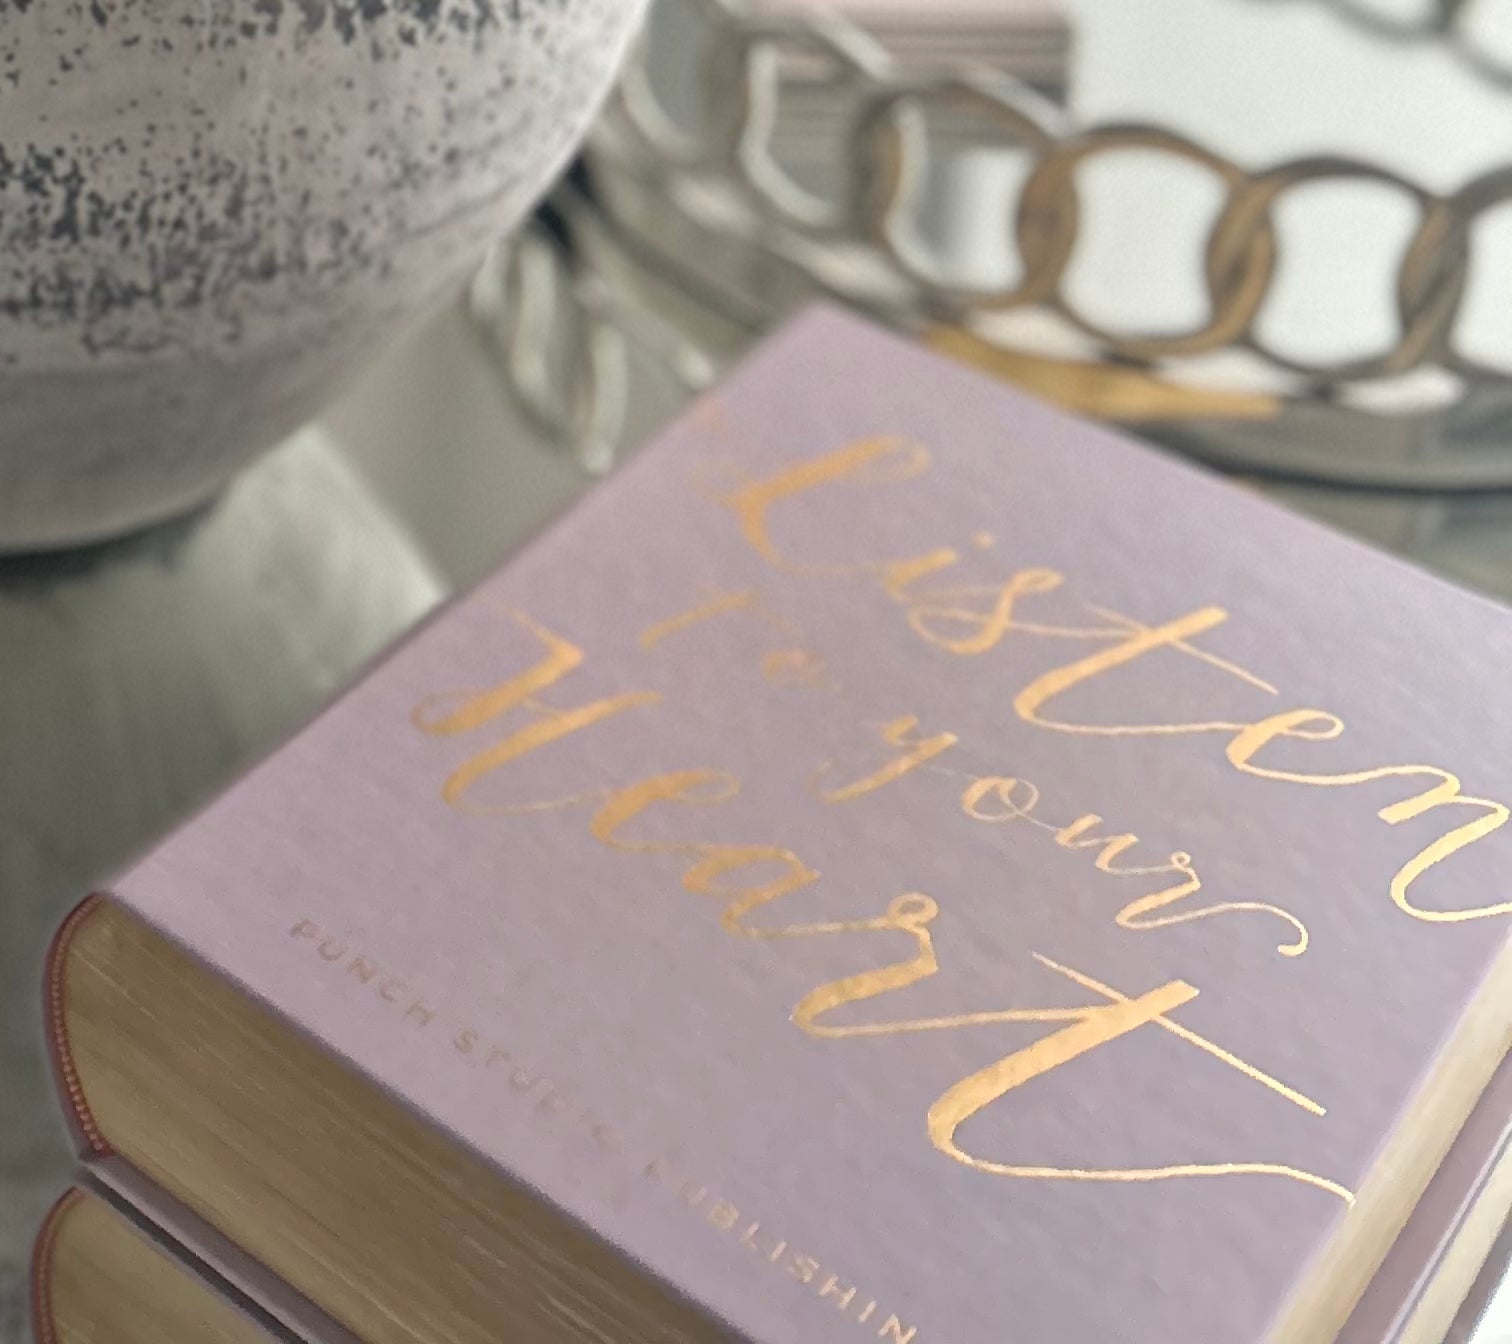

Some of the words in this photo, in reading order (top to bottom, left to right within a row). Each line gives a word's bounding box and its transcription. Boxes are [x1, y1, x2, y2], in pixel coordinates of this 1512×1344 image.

[688, 400, 1512, 923] Listen
[806, 712, 1308, 957] your
[289, 918, 437, 1026] PUNCH
[452, 1026, 626, 1154] STUD
[410, 608, 1356, 1209] Heart
